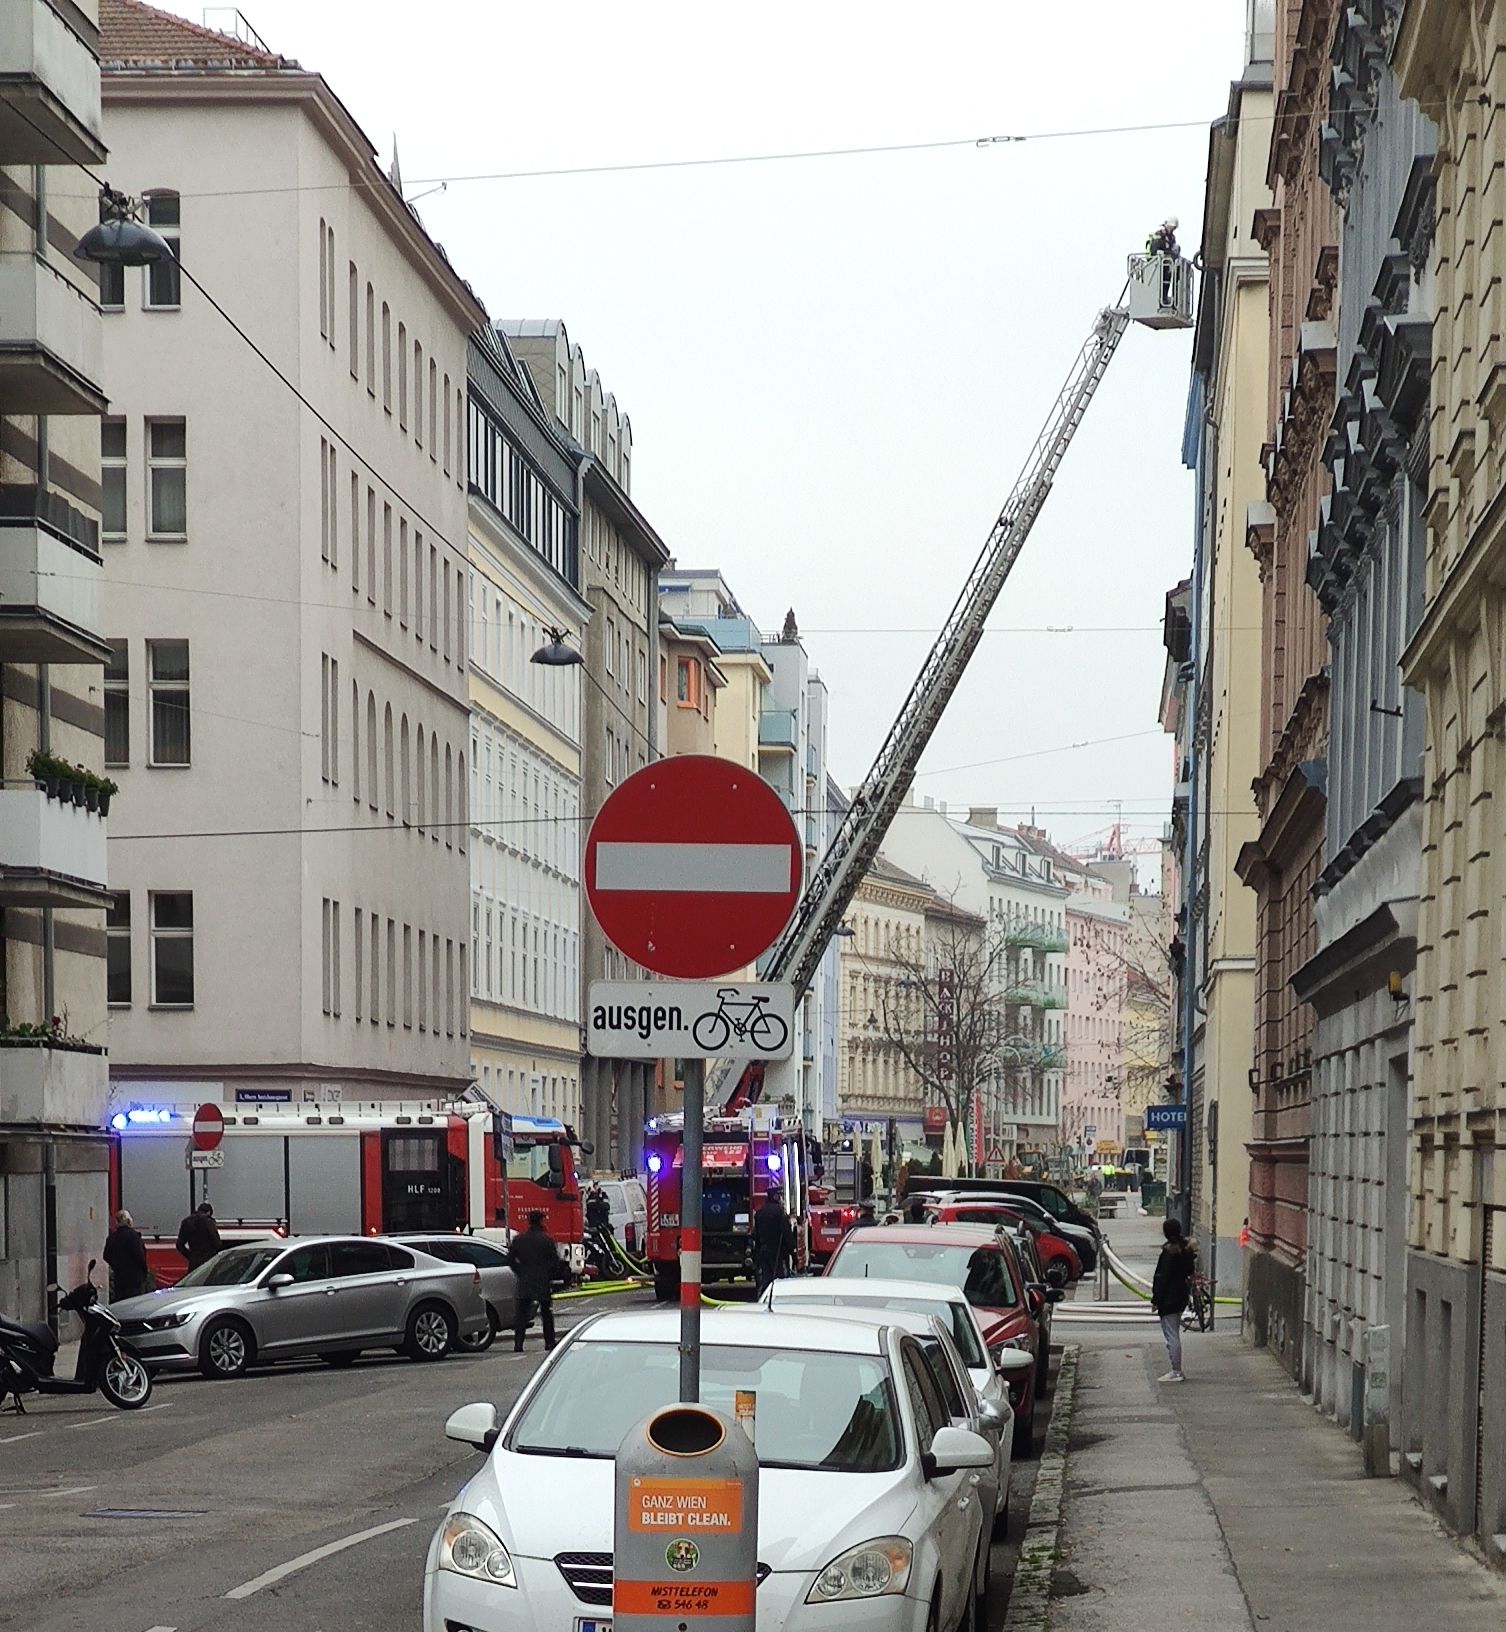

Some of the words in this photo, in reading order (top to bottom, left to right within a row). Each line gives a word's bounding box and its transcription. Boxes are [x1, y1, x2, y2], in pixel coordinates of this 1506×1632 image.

[593, 1004, 689, 1039] ausgen.
[407, 1184, 425, 1194] HLF
[641, 1495, 673, 1508] GANZ
[676, 1495, 707, 1509] WIEN
[641, 1512, 684, 1525] BLEIBT
[687, 1513, 731, 1526] CLEAN.
[651, 1586, 719, 1597] MISTTELEFON
[674, 1599, 692, 1609] 546
[695, 1599, 709, 1609] 48
